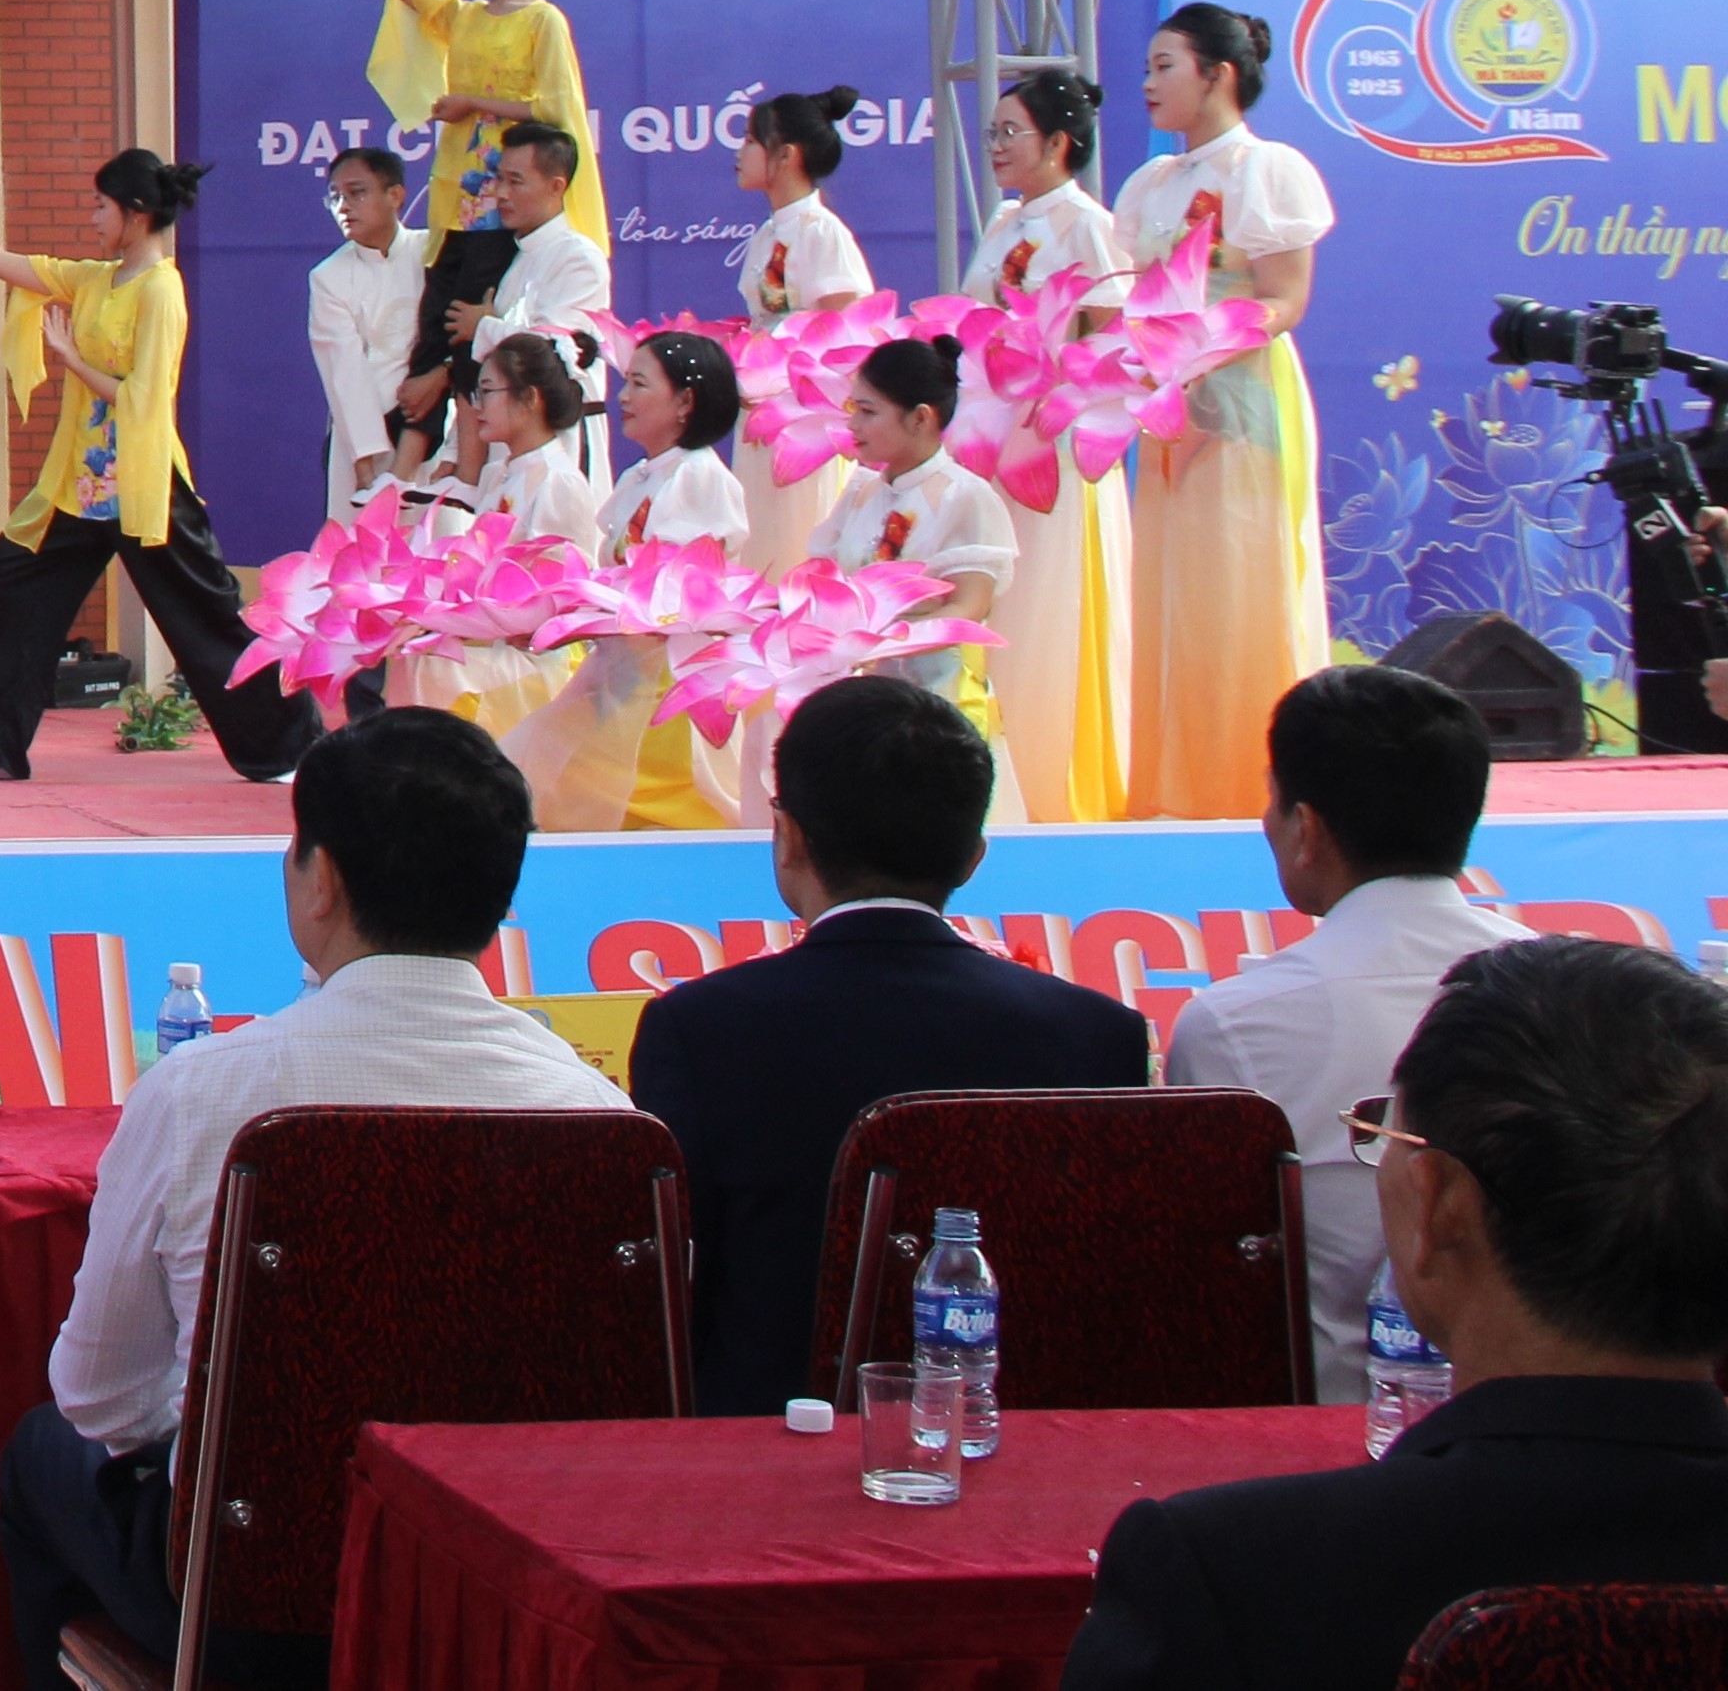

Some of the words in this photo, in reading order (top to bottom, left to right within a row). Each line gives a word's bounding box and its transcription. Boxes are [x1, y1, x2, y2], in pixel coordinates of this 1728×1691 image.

[1347, 49, 1403, 68] 1965
[1347, 77, 1403, 97] 2025
[621, 82, 765, 153] QUỐ
[838, 97, 936, 147] GIA
[1508, 108, 1583, 131] Năm
[258, 118, 371, 177] ĐẠT
[1595, 204, 1689, 280] thầy
